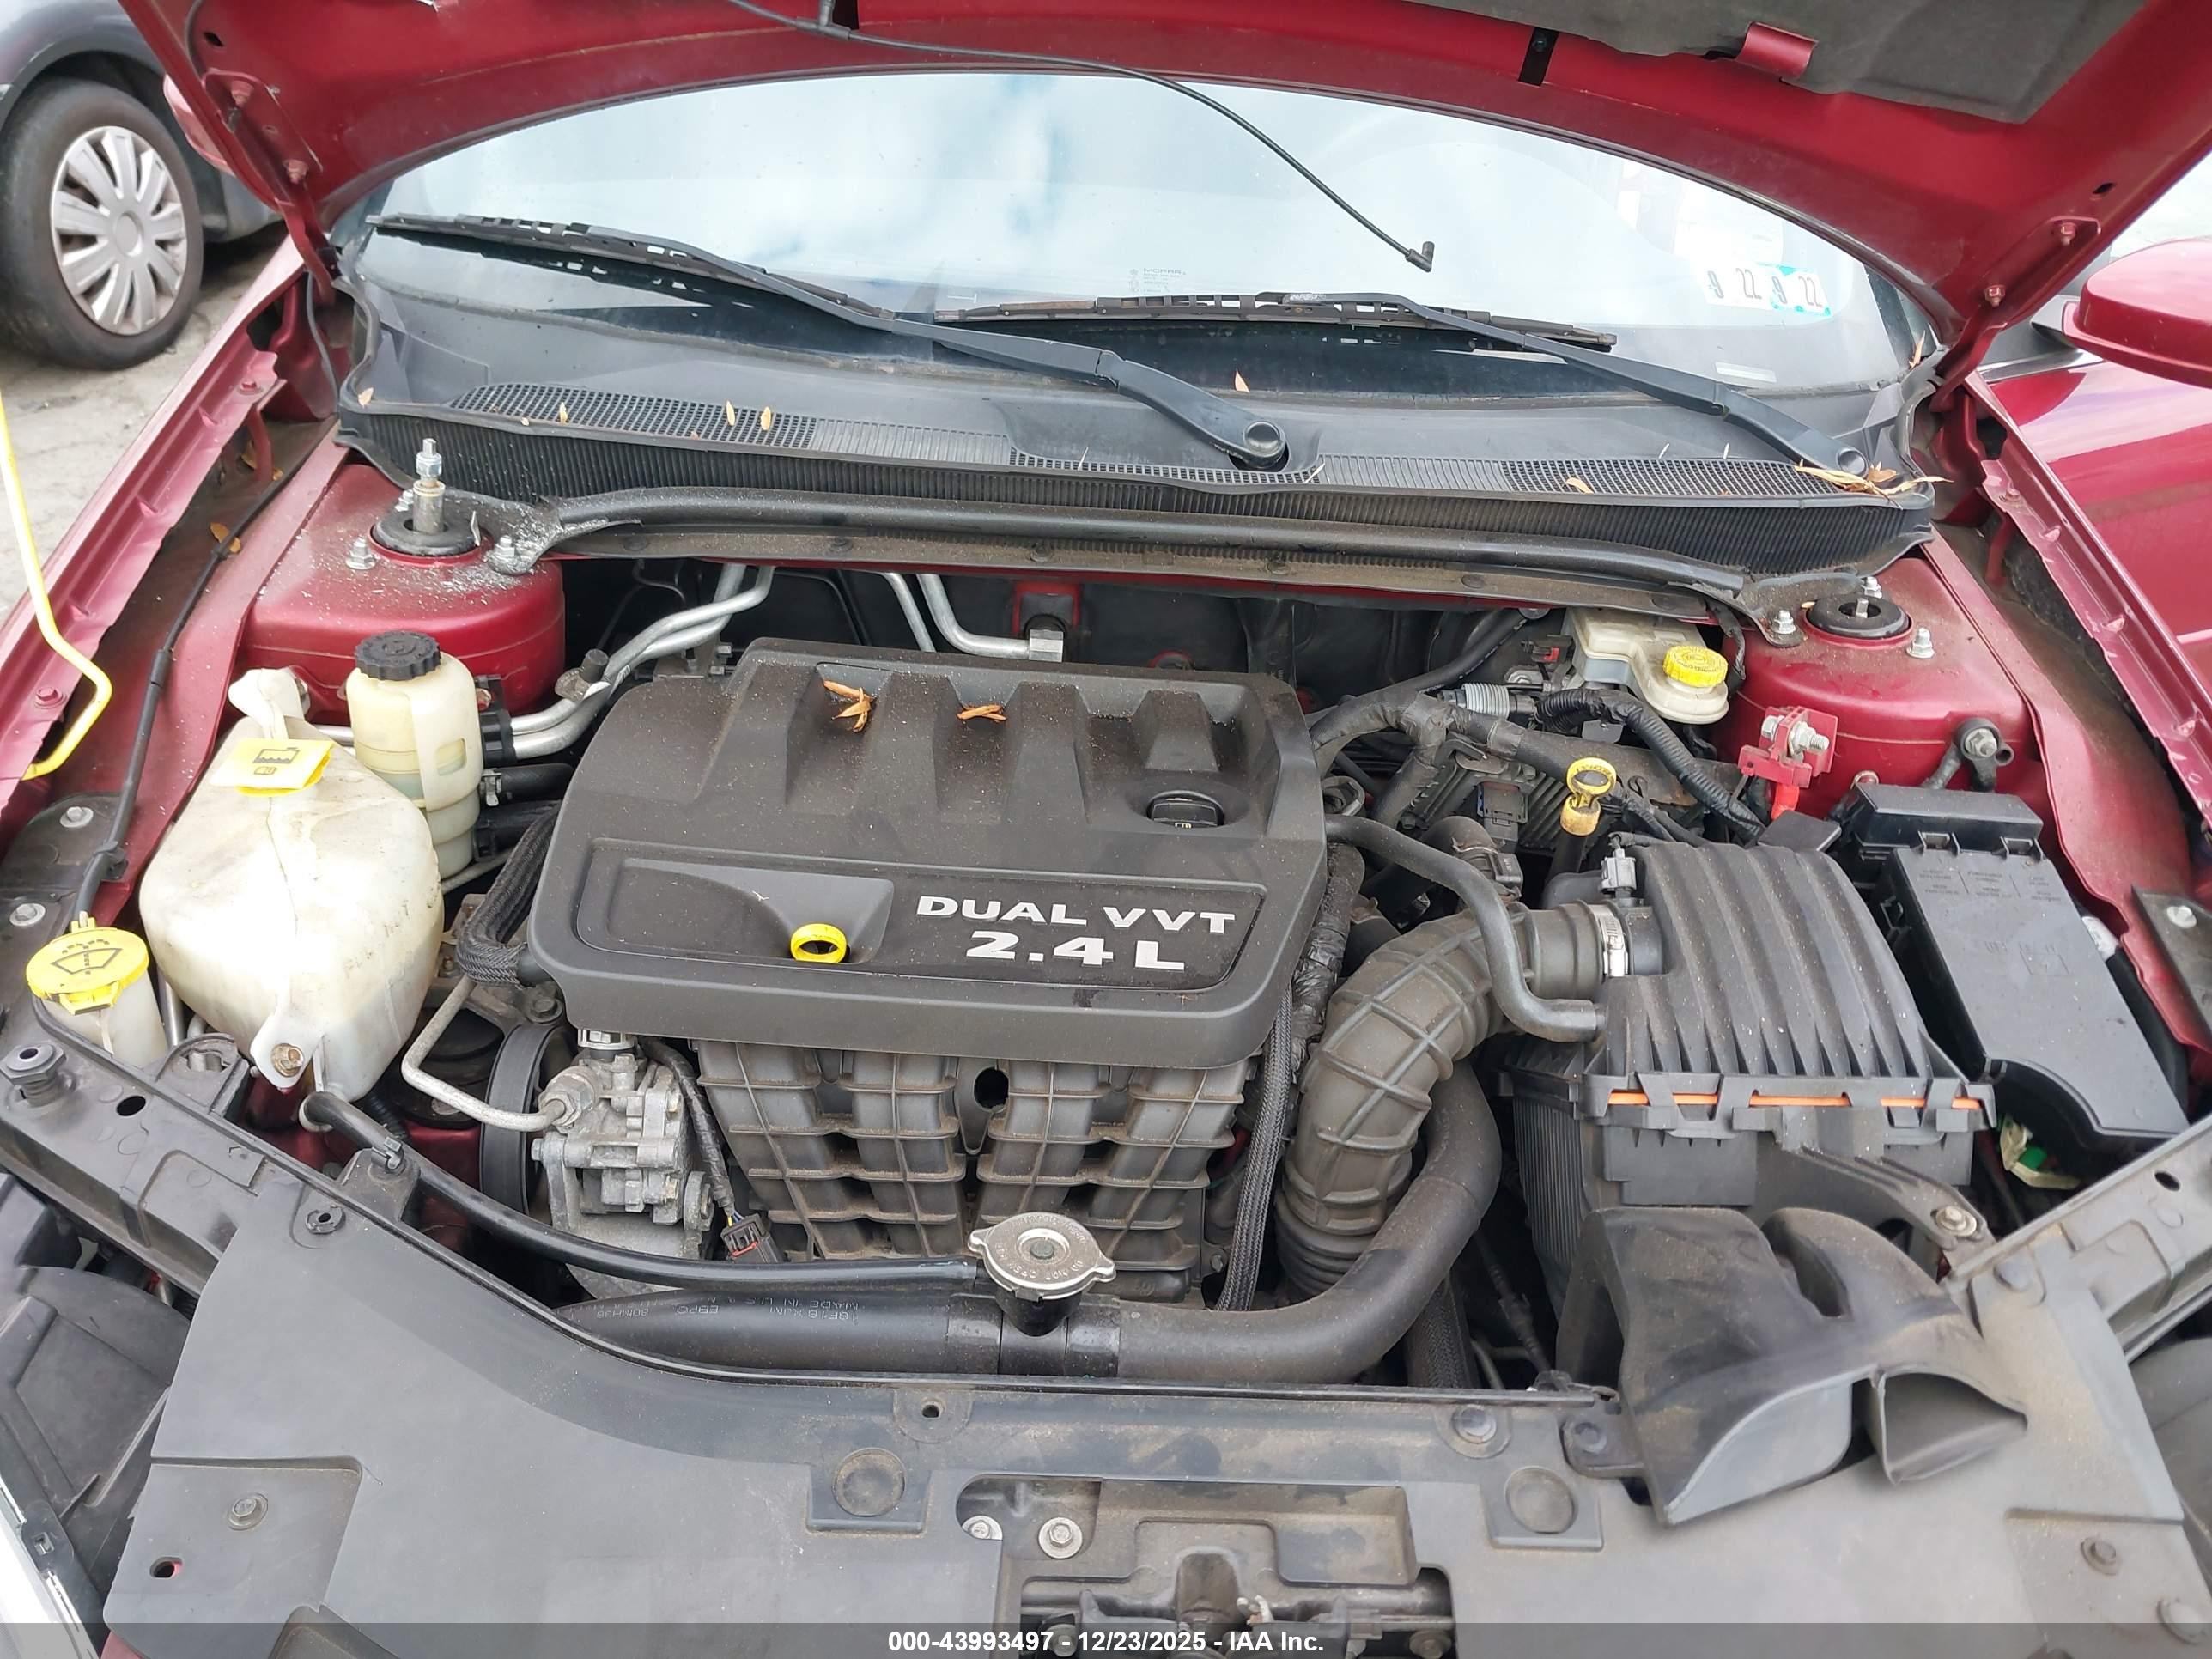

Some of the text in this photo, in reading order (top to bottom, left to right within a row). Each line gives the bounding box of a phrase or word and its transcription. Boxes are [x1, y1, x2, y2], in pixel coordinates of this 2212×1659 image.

[1735, 267, 1763, 300] 22
[1798, 276, 1823, 307] 22
[916, 896, 1236, 934] DUAL VVT
